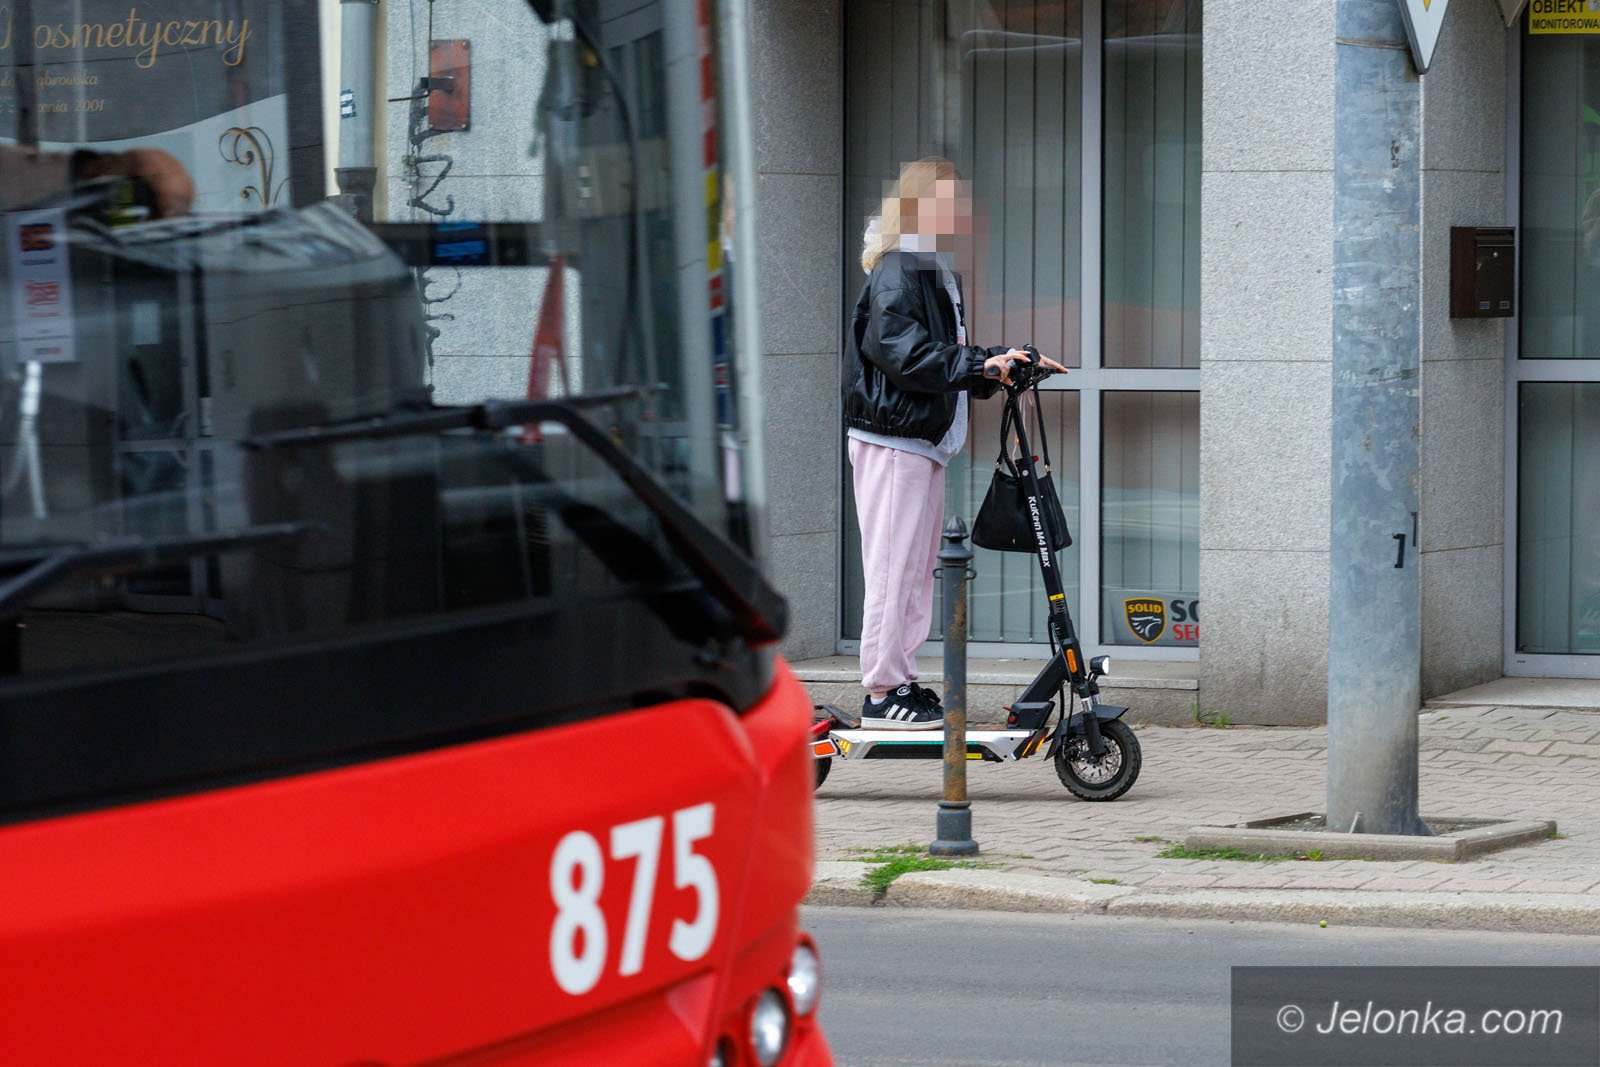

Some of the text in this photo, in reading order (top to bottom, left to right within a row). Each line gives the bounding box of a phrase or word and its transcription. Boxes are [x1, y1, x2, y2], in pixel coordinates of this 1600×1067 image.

[1533, 0, 1585, 13] OBIEKT
[1532, 18, 1600, 29] MONITOROWA
[0, 6, 251, 69] osmetyczny
[1035, 531, 1047, 546] M4
[1127, 603, 1162, 613] SOLID
[550, 801, 720, 996] 875
